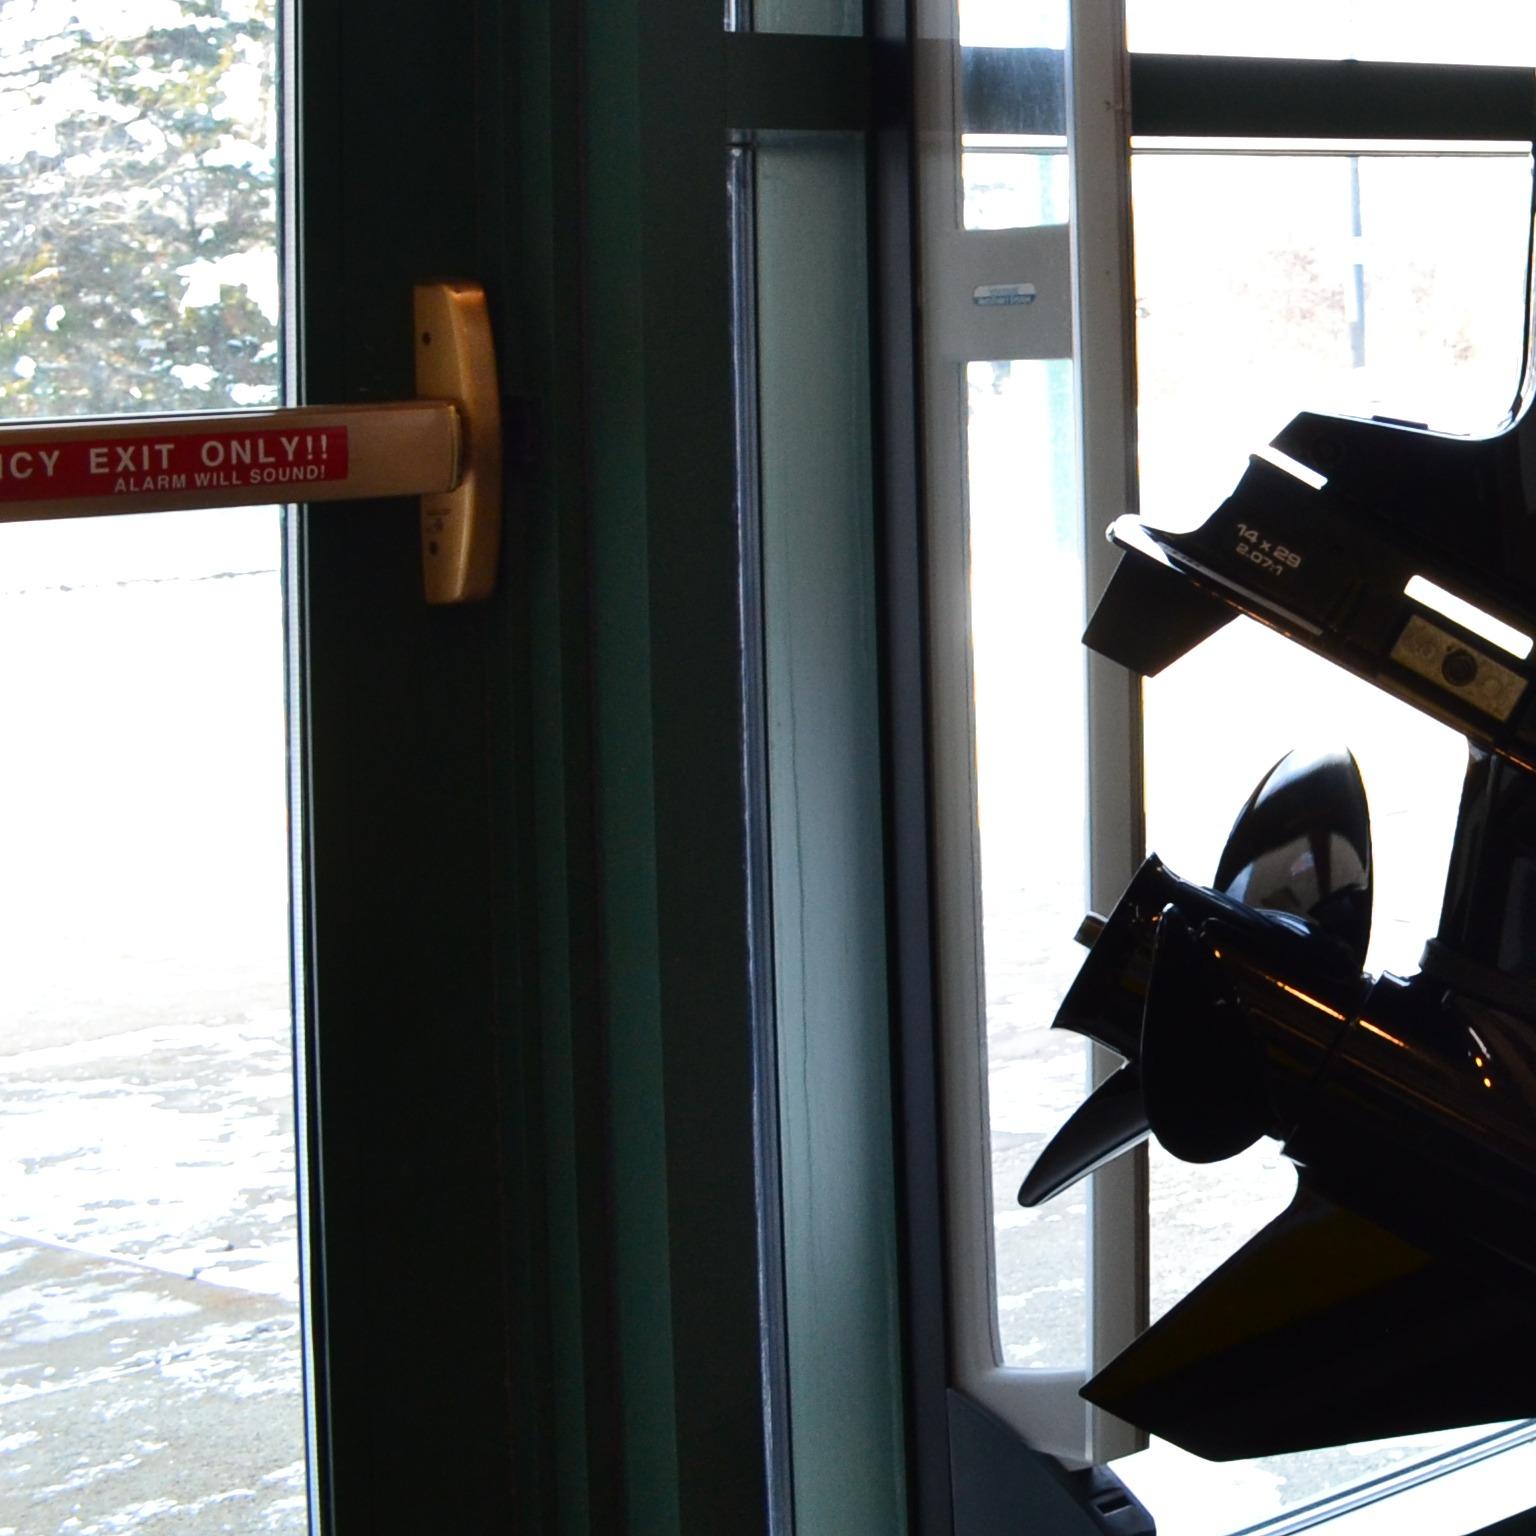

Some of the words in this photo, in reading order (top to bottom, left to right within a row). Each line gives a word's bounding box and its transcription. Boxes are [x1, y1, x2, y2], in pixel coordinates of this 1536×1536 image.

[89, 444, 175, 475] EXIT
[200, 435, 329, 468] ONLY!!
[115, 473, 188, 493] ALARM
[194, 470, 243, 487] WILL
[250, 465, 326, 485] SOUND!
[1236, 523, 1259, 543] 14
